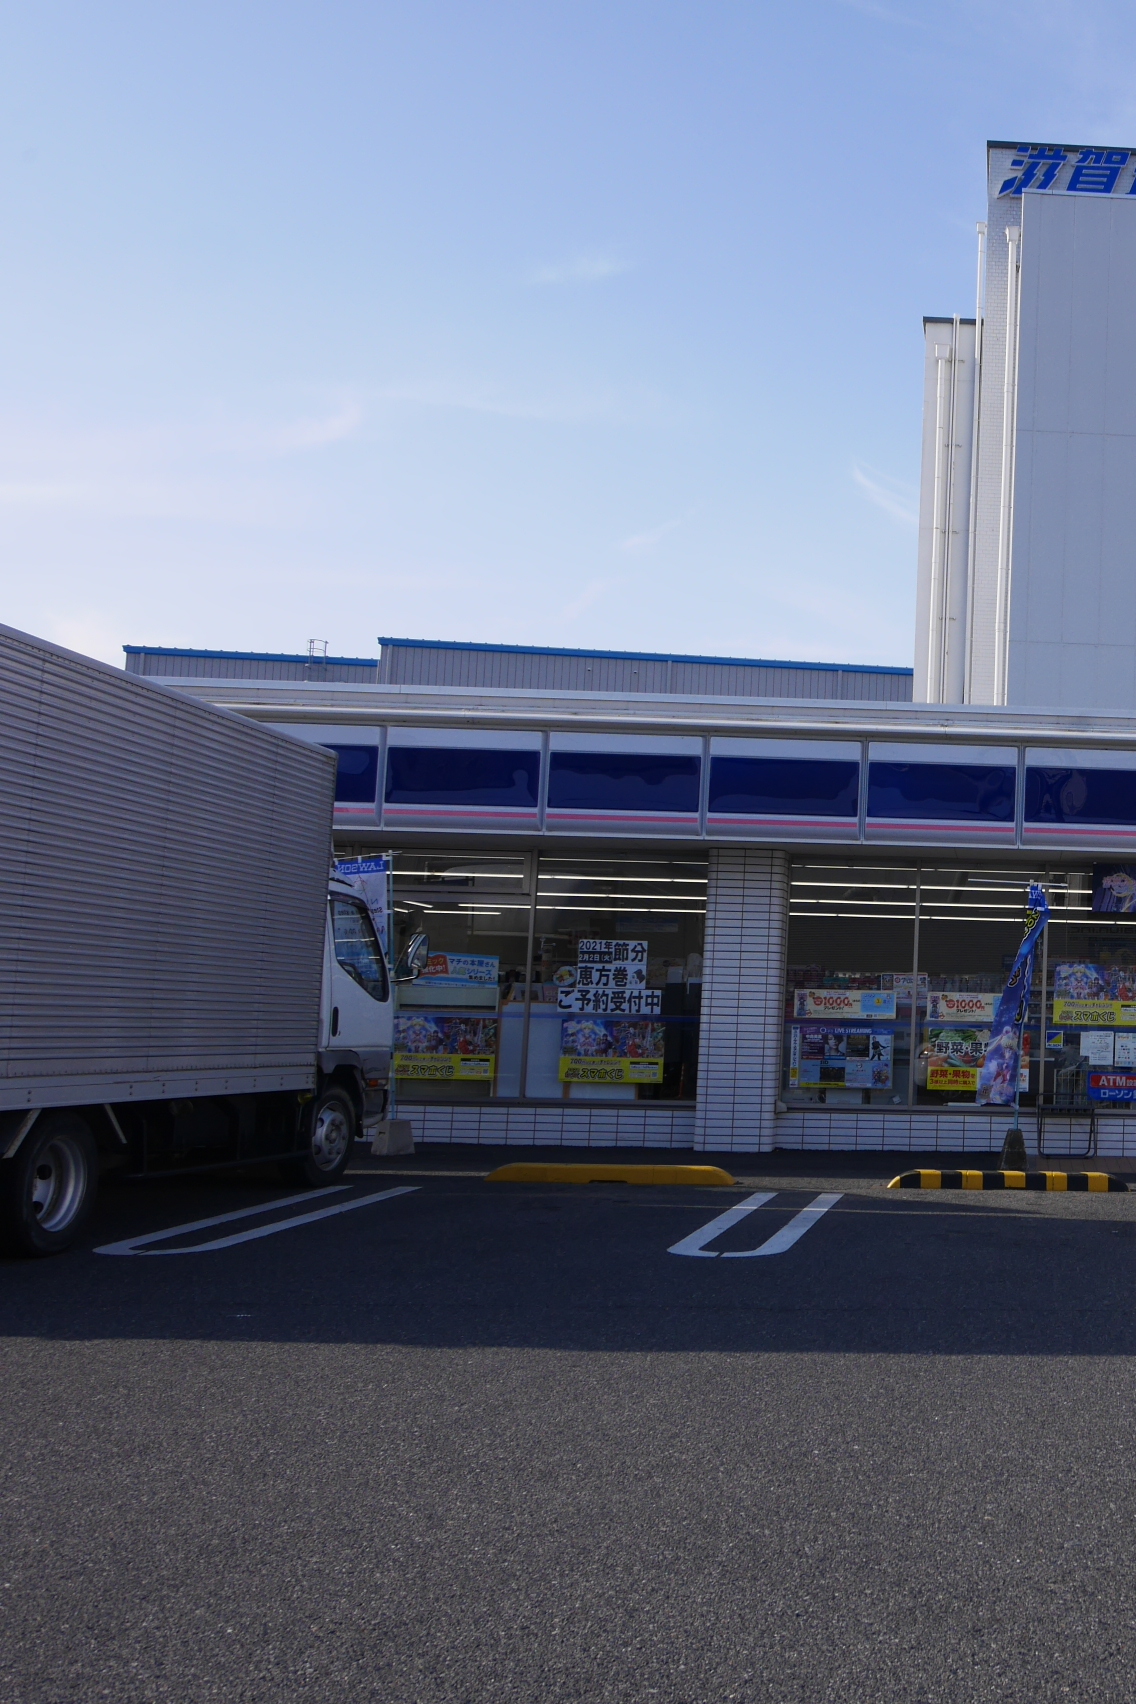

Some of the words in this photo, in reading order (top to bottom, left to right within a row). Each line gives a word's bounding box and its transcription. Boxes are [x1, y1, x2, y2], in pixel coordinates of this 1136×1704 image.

[579, 940, 613, 951] 2021年
[614, 941, 647, 963] 節分
[427, 957, 445, 965] ミック
[448, 957, 496, 969] マチの本屋さん
[577, 965, 628, 988] 恵方巻
[558, 989, 661, 1015] ご予約受付中
